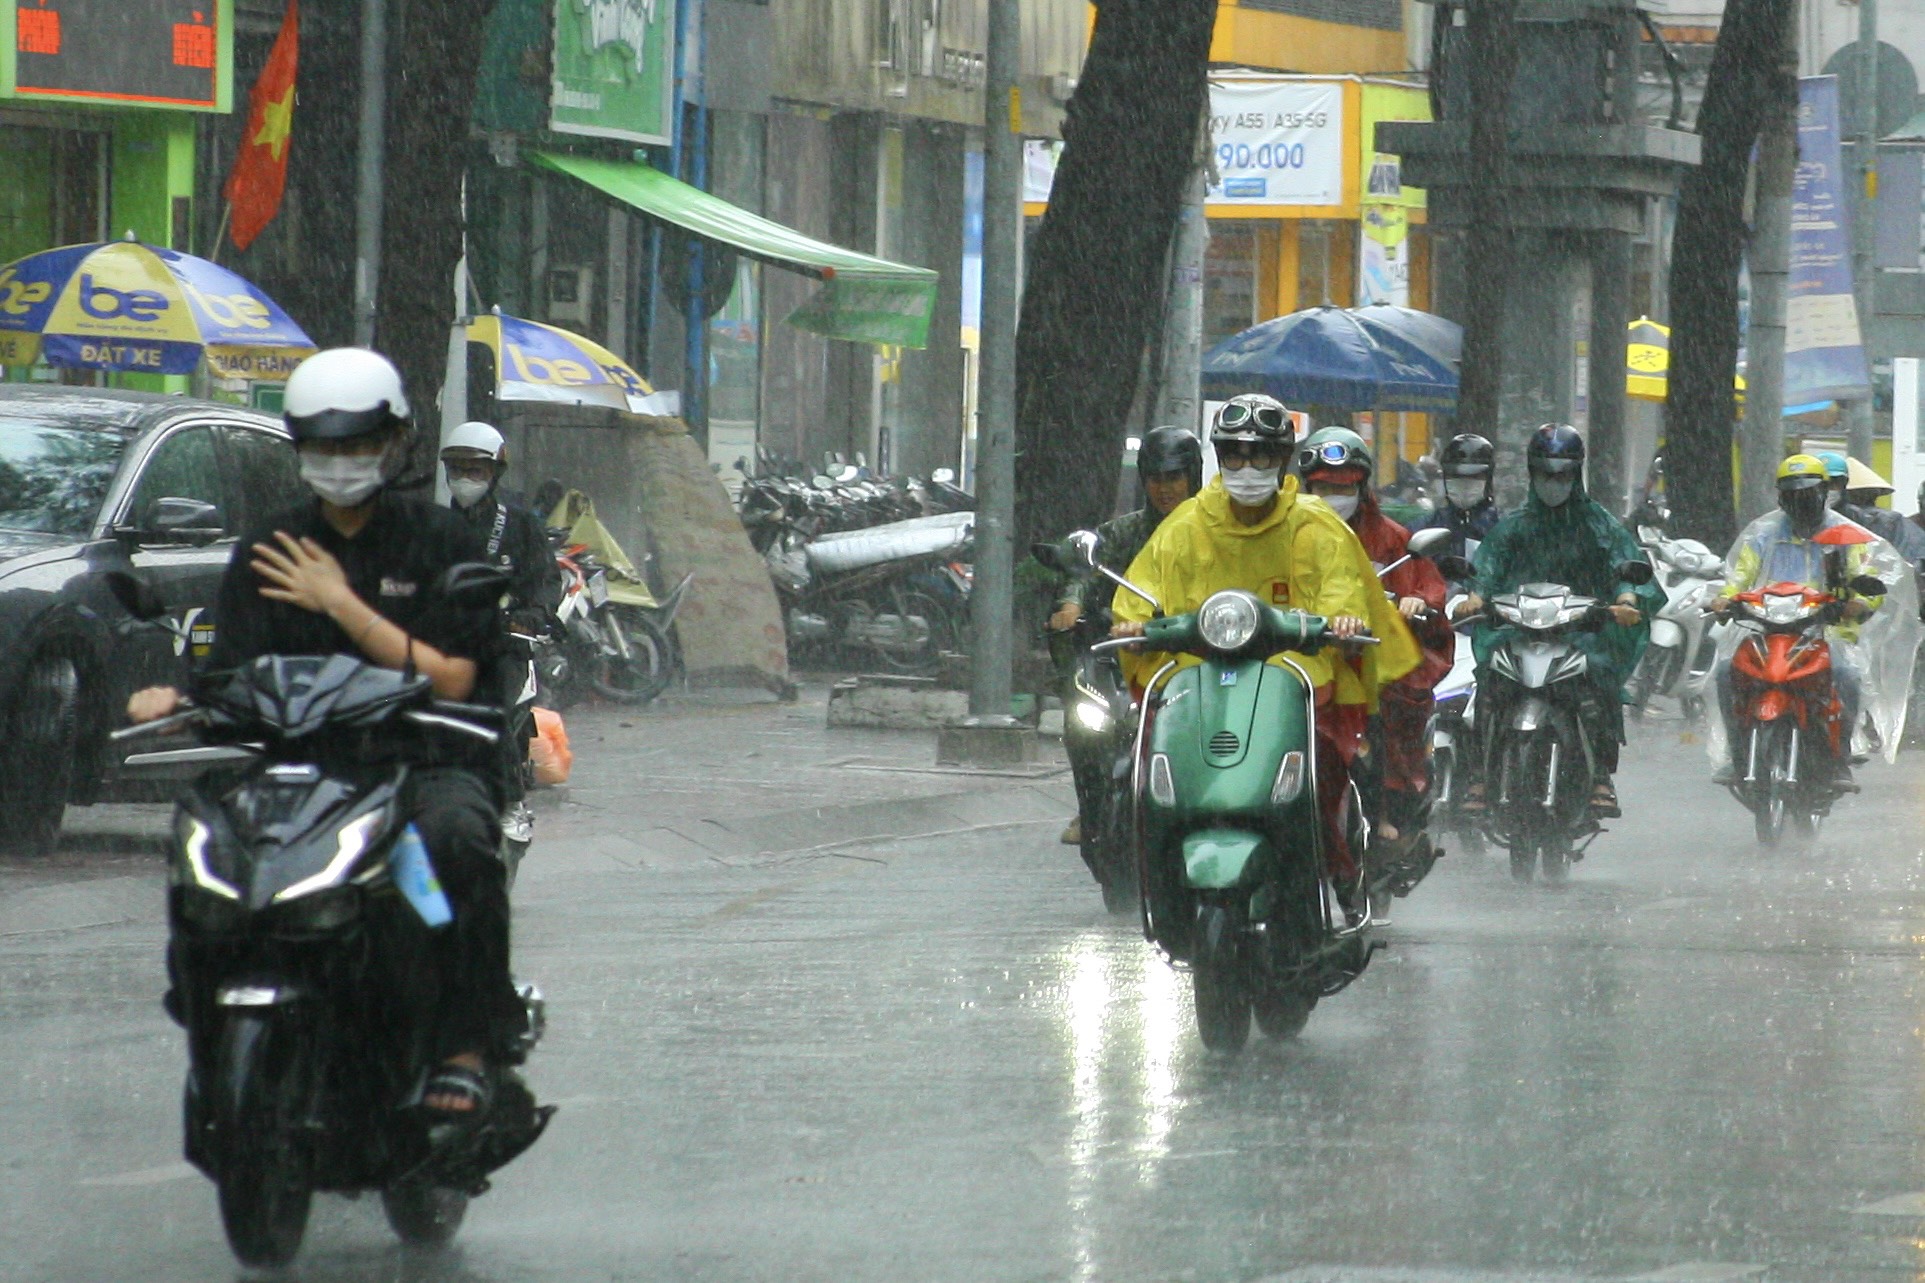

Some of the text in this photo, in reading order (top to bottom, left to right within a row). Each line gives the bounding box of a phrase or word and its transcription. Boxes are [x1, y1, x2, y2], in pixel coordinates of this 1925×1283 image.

[1234, 112, 1264, 128] A55
[1216, 142, 1304, 169] 90.000
[80, 274, 169, 322] be
[131, 348, 161, 366] XE
[506, 344, 592, 386] be
